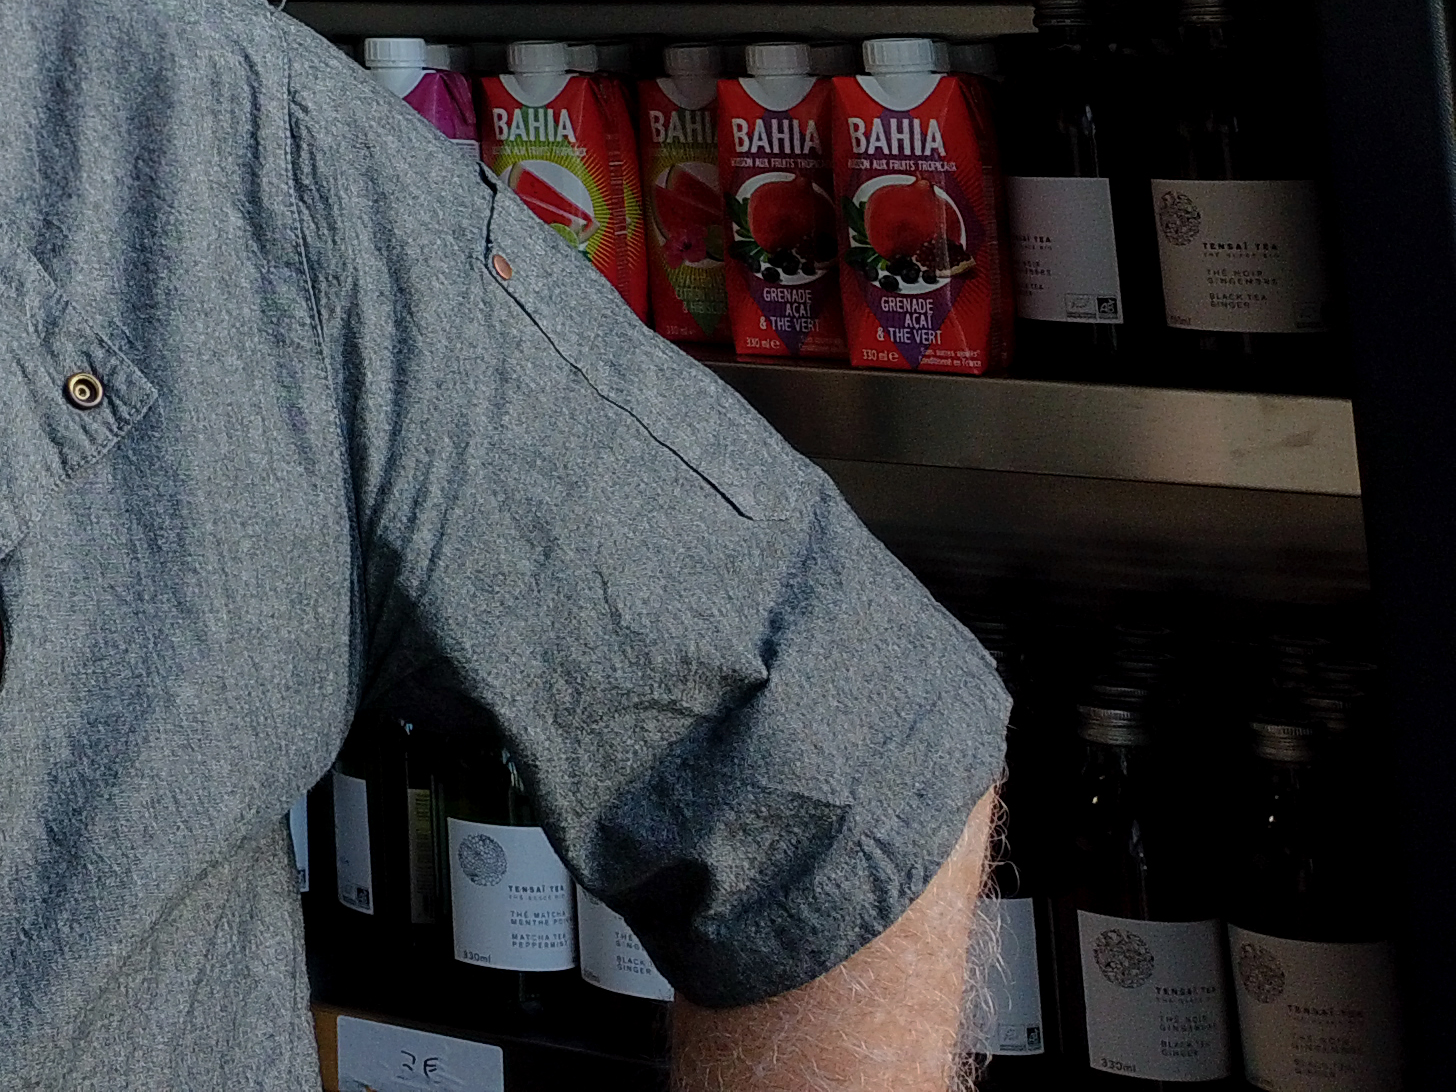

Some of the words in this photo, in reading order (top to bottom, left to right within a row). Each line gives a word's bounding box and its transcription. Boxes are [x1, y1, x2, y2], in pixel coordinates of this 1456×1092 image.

[492, 107, 577, 143] BAHIA
[649, 109, 718, 144] BAHI
[731, 117, 823, 155] BAHIA
[847, 116, 947, 157] BAHIA
[755, 157, 769, 168] AUX
[771, 157, 795, 169] FRUITS
[872, 159, 888, 170] AUX
[889, 159, 916, 171] FRUITS
[1255, 242, 1278, 250] TEA
[763, 287, 812, 304] GRENADE
[1209, 292, 1243, 301] BLACK
[1246, 293, 1267, 301] TEA
[880, 296, 934, 314] GRENADE
[759, 316, 767, 330] &
[770, 317, 791, 332] THE
[793, 318, 820, 333] VERT
[876, 326, 885, 341] &
[887, 327, 912, 344] THE
[913, 328, 942, 345] VERT
[746, 336, 760, 348] 330
[862, 348, 877, 361] 330
[962, 358, 982, 368] France
[508, 885, 546, 893] TENSAÏ
[549, 885, 565, 893] TEA
[533, 910, 566, 918] MATCHA
[511, 918, 549, 926] MENTHE
[511, 933, 549, 941] MATCHA
[616, 955, 646, 966] BLACK
[617, 963, 652, 975] GINGER
